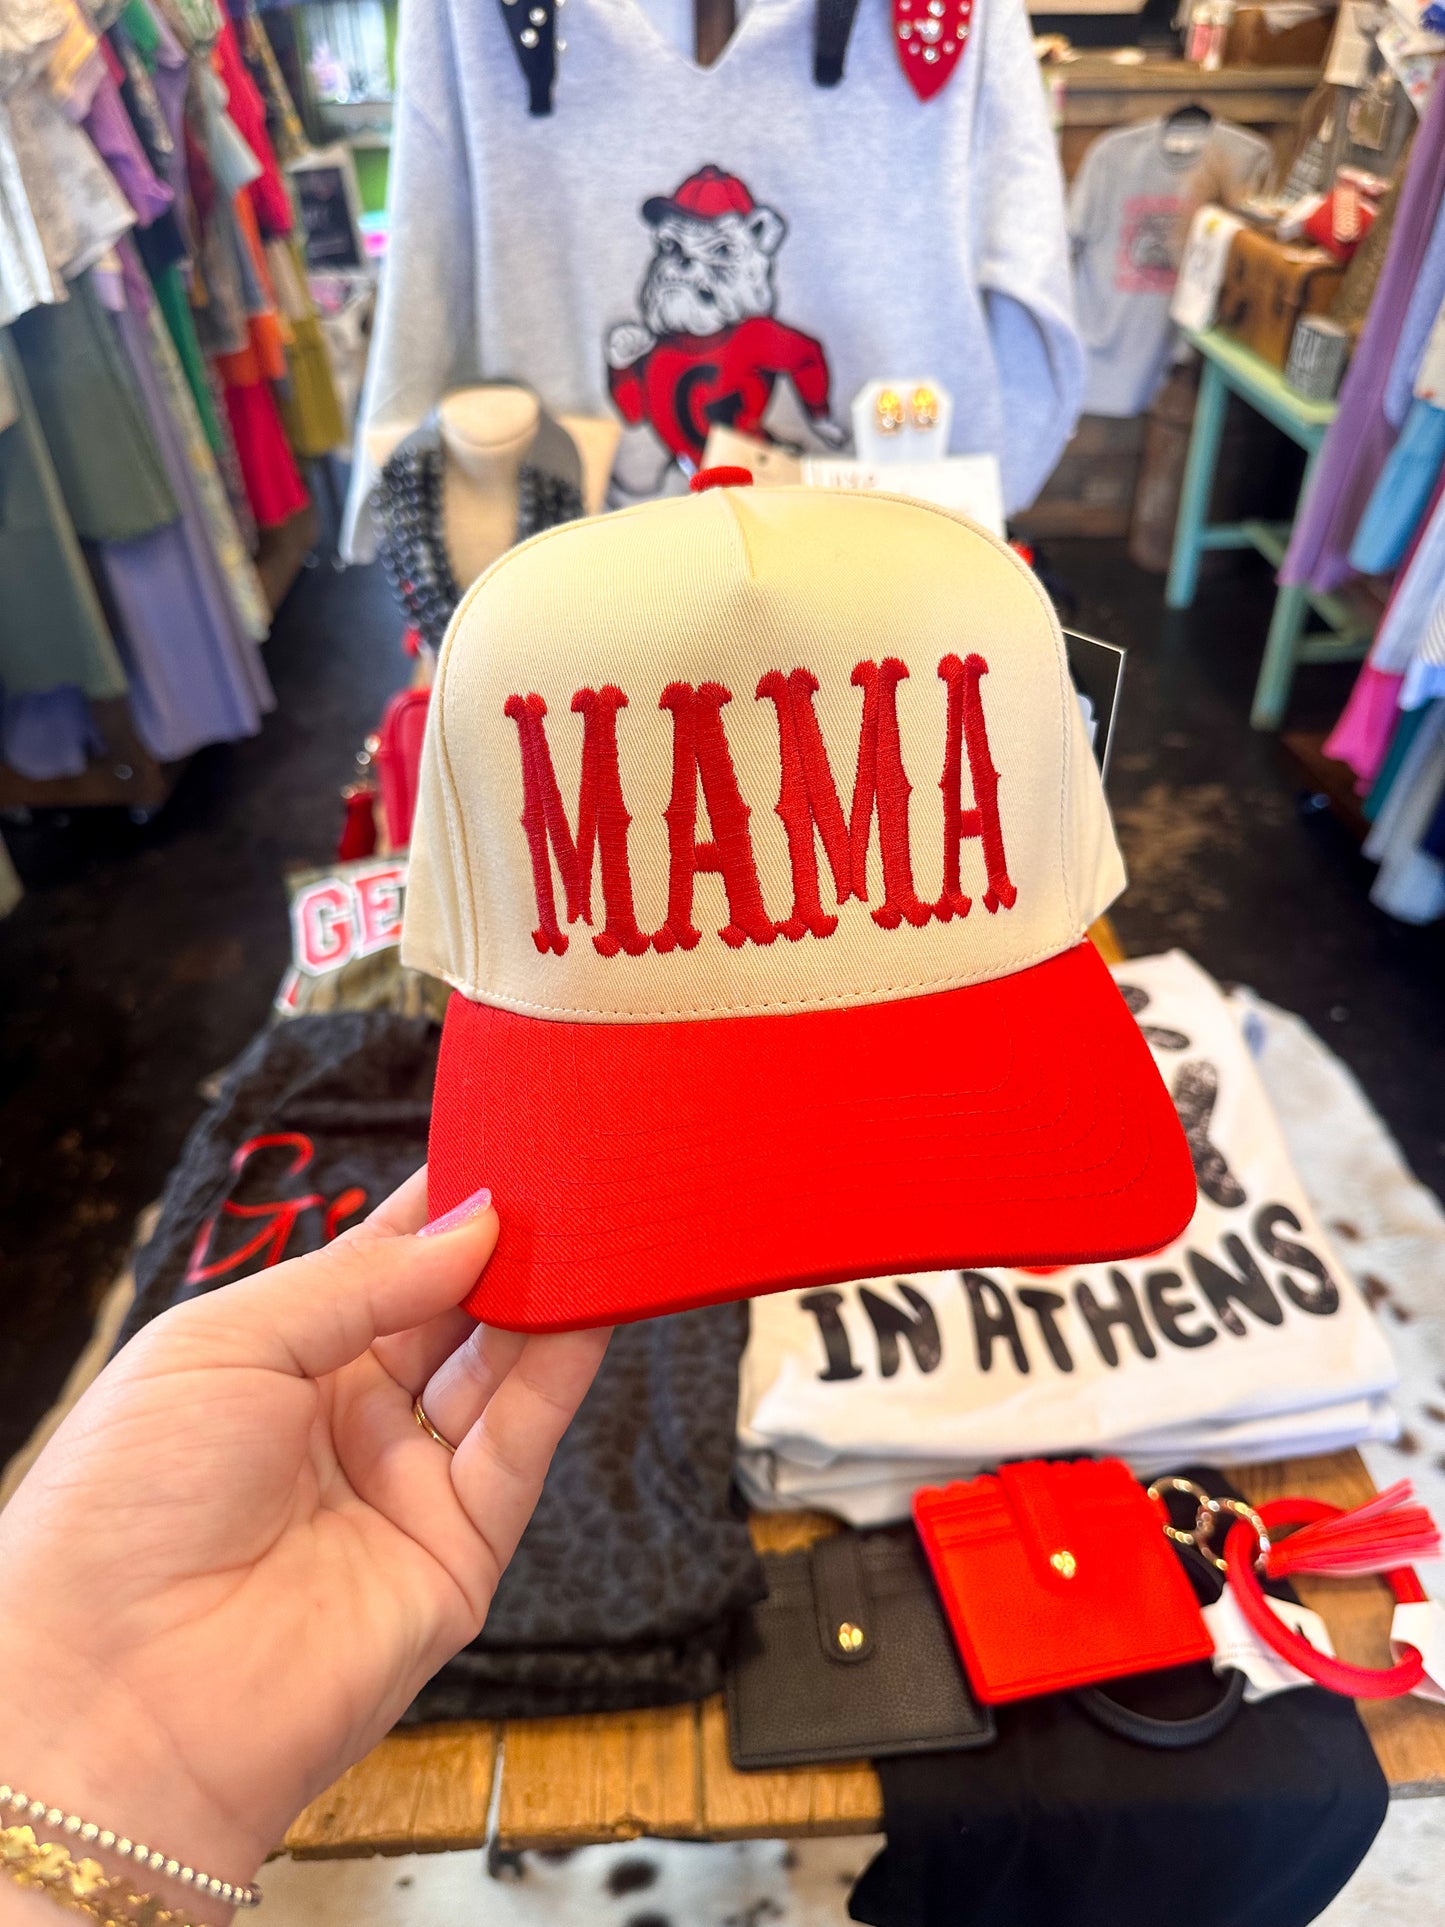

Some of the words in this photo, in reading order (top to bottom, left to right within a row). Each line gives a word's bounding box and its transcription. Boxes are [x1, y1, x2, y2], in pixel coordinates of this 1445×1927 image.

[504, 653, 1018, 957] MAMA
[802, 1281, 942, 1382] IN
[962, 1204, 1340, 1374] ATHENS
